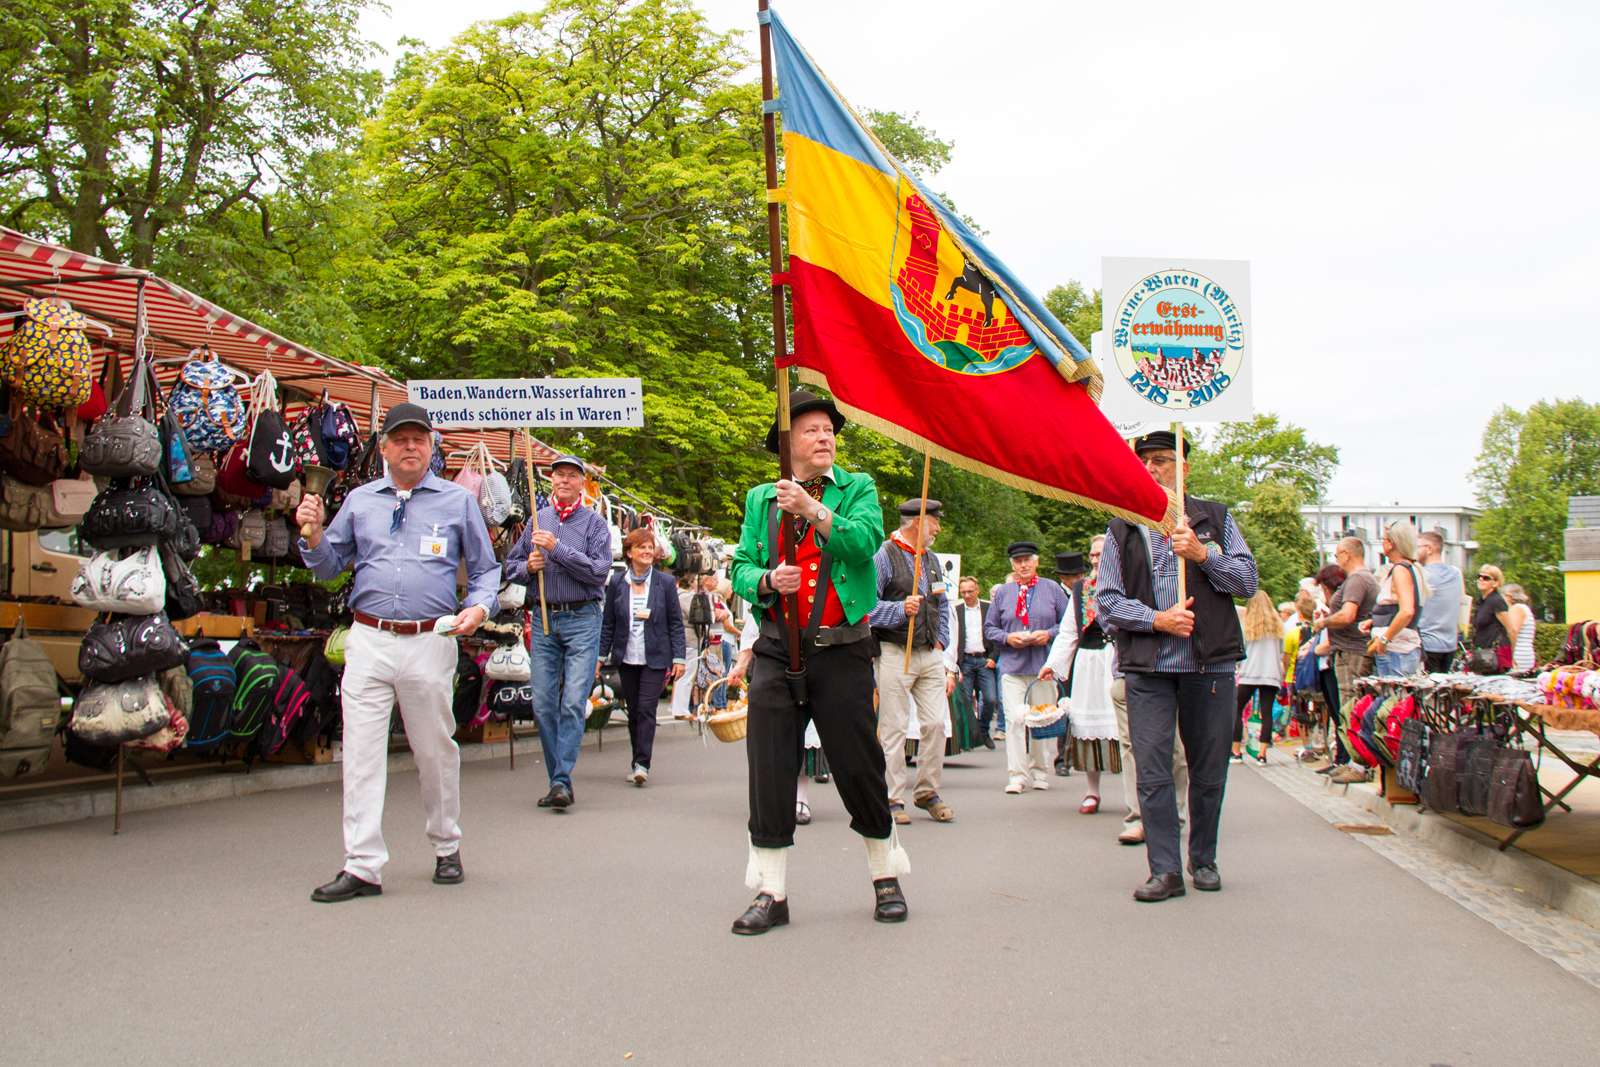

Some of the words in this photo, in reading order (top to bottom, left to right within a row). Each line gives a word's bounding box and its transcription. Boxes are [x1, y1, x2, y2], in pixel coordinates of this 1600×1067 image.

[1132, 319, 1224, 342] erwähnung
[1126, 369, 1170, 405] 1218
[1186, 371, 1231, 407] 2018
[424, 408, 475, 424] rgends
[478, 407, 532, 421] schöner
[536, 407, 556, 421] als
[560, 407, 574, 421] in
[577, 407, 622, 421] Waren
